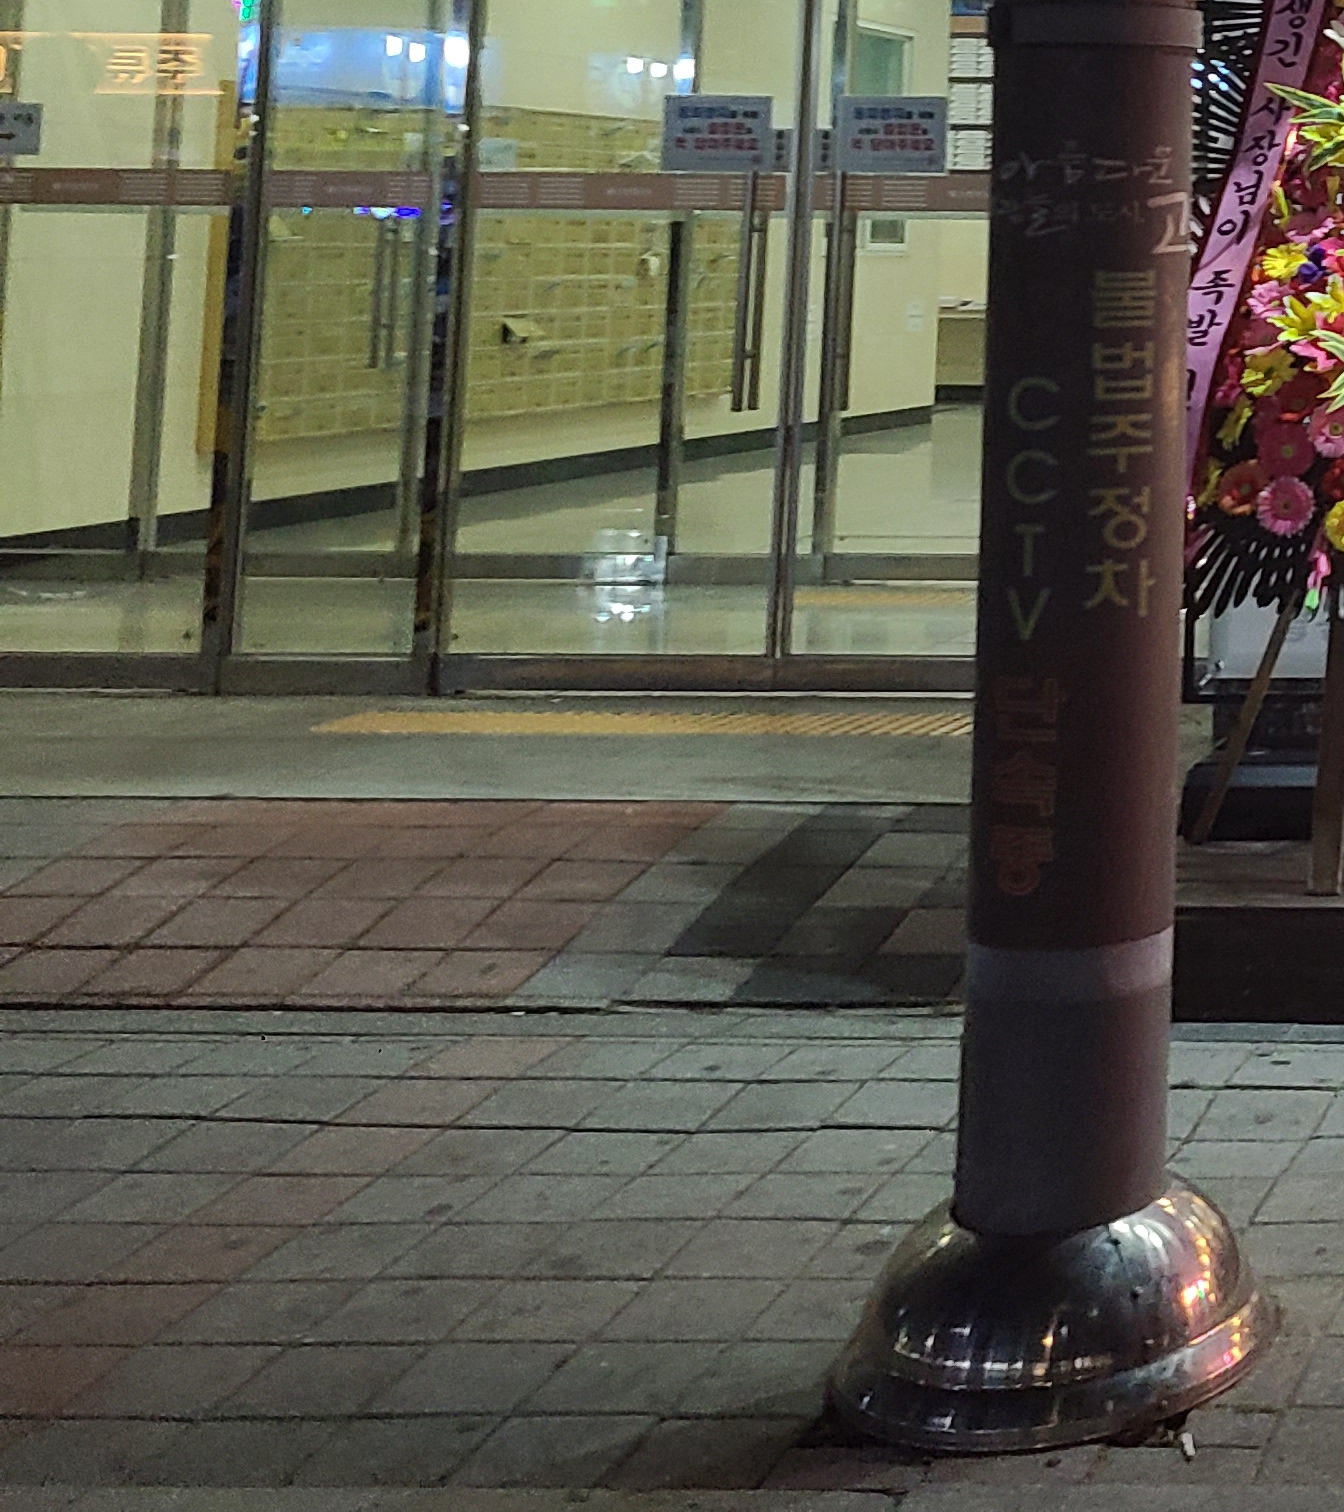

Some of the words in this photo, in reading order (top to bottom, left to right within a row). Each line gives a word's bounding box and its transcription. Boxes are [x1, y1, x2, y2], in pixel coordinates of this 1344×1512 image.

[1215, 94, 1292, 245] 사장님이
[1182, 268, 1236, 347] 족발
[1005, 376, 1061, 641] CCTV
[1083, 269, 1158, 621] 불법주정차
[989, 676, 1070, 898] 단속중
